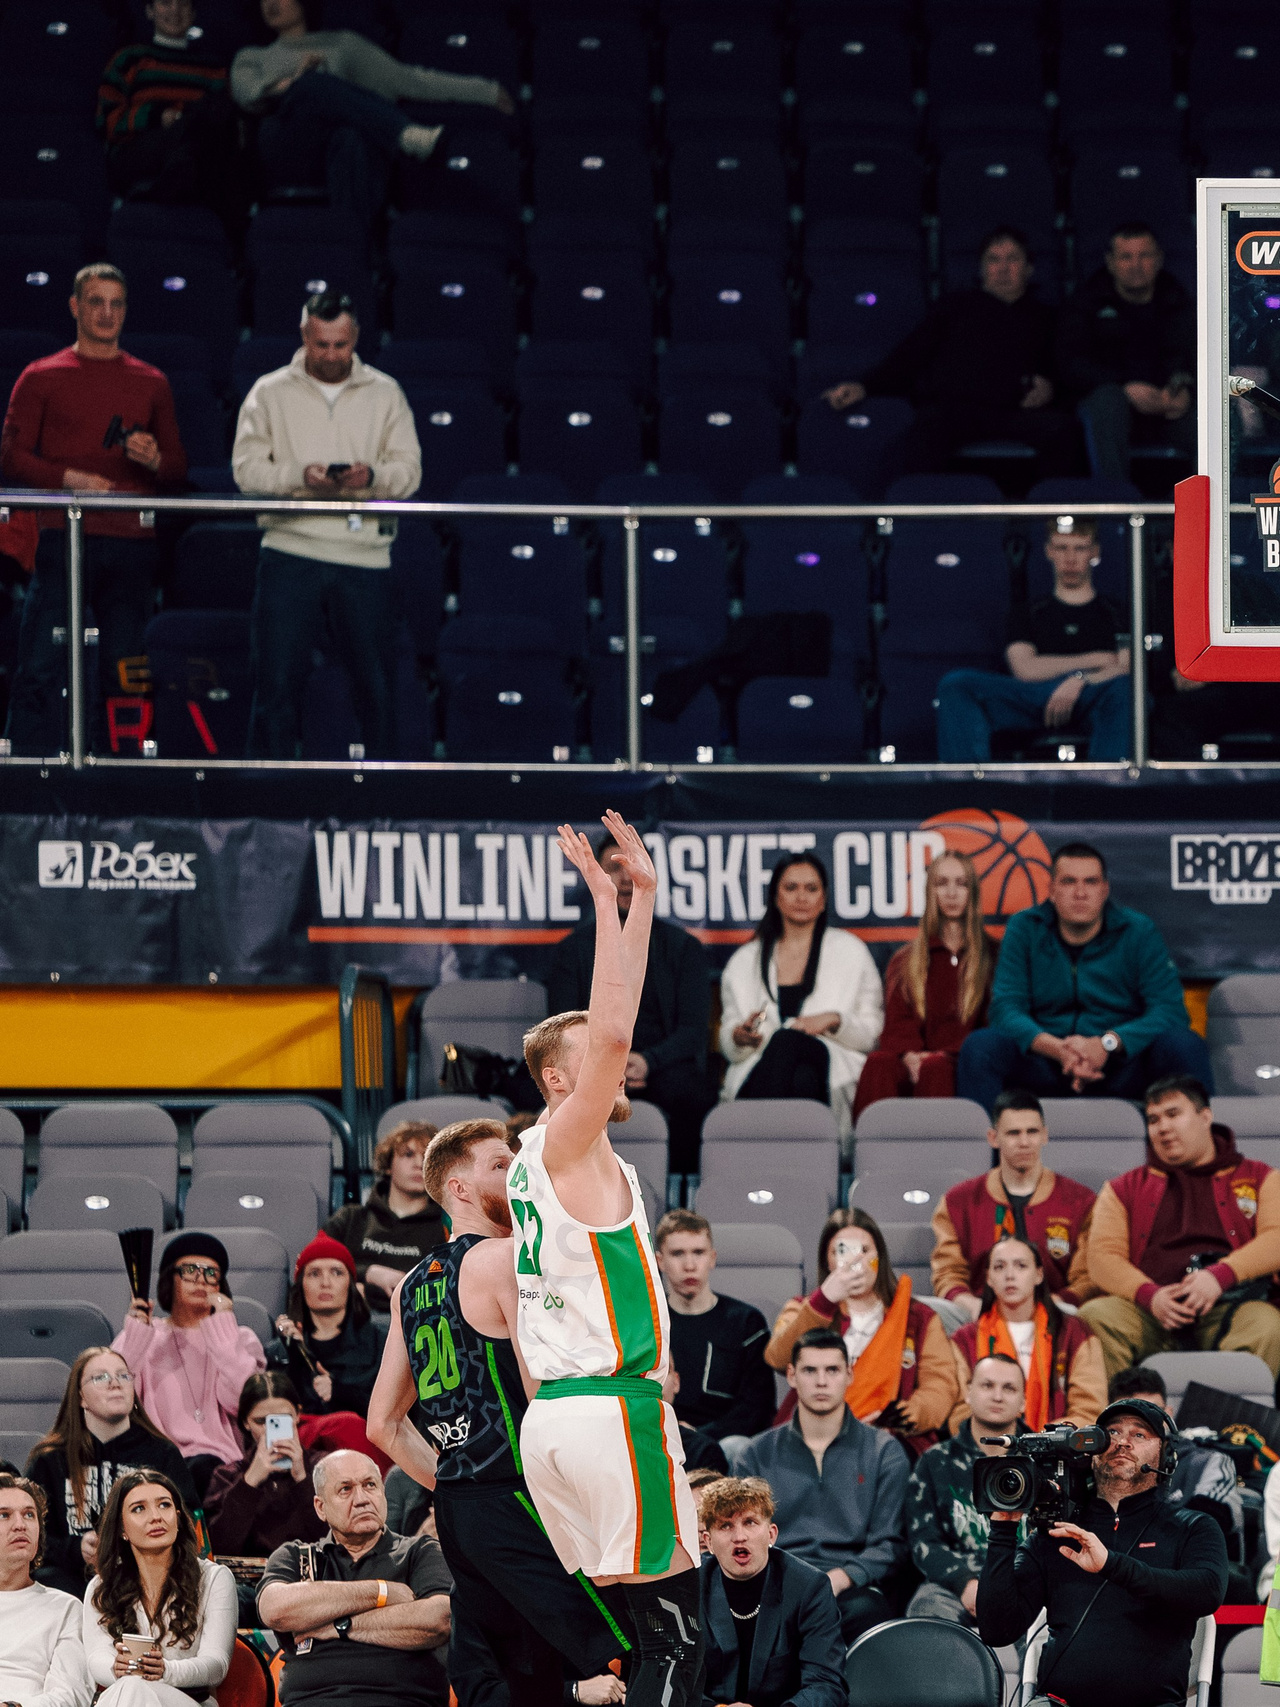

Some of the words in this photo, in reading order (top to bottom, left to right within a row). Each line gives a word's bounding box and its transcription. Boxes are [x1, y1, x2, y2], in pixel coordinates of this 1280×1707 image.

[90, 840, 198, 881] Робек
[314, 830, 581, 921] WINLINE
[833, 831, 946, 920] CUP
[415, 1315, 461, 1401] 20
